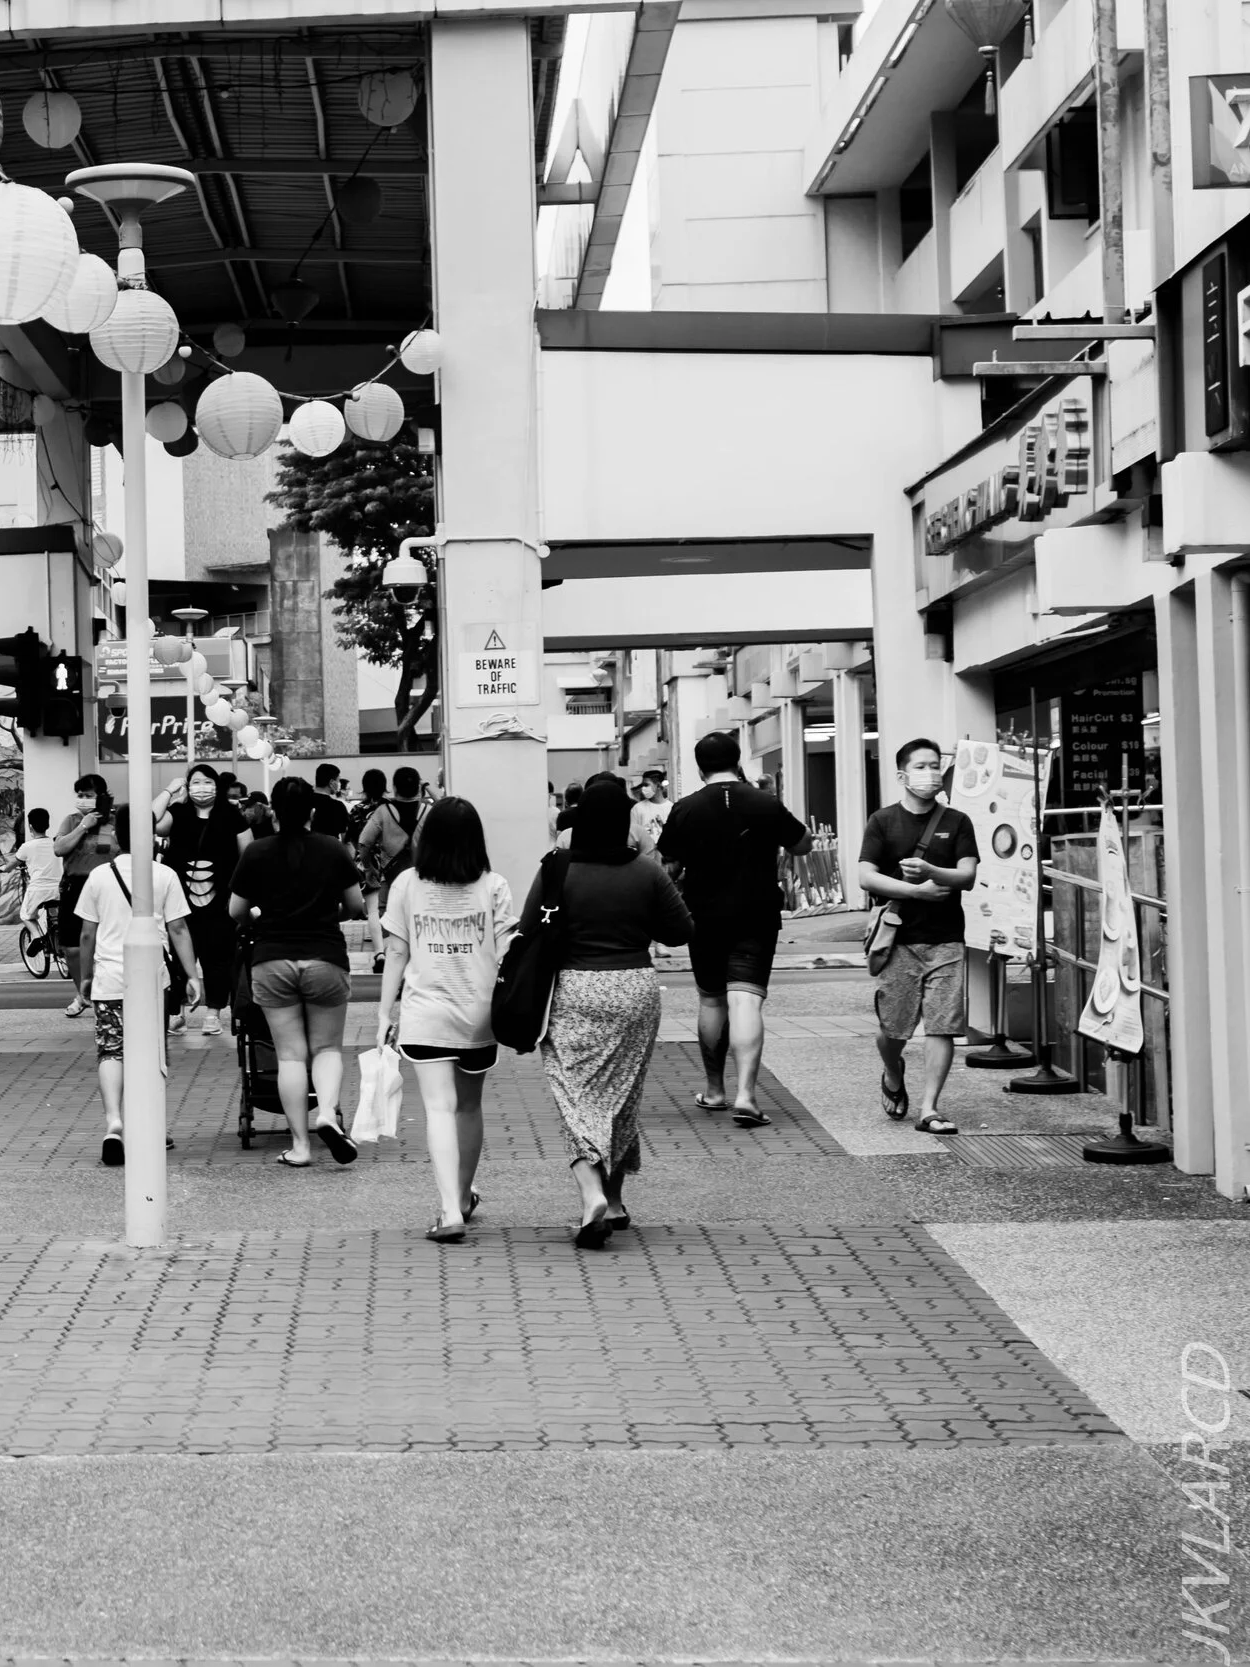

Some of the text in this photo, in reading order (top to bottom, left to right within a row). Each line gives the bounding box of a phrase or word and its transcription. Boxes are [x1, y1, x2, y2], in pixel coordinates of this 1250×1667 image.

[475, 658, 517, 670] BEWARE
[490, 671, 502, 682] OF
[477, 682, 517, 694] TRAFFIC
[1071, 713, 1114, 722] HairCut
[120, 715, 214, 736] FrPrice
[1072, 742, 1109, 751] Colour
[1073, 770, 1108, 779] Facial
[428, 943, 473, 954] TOO SWEET
